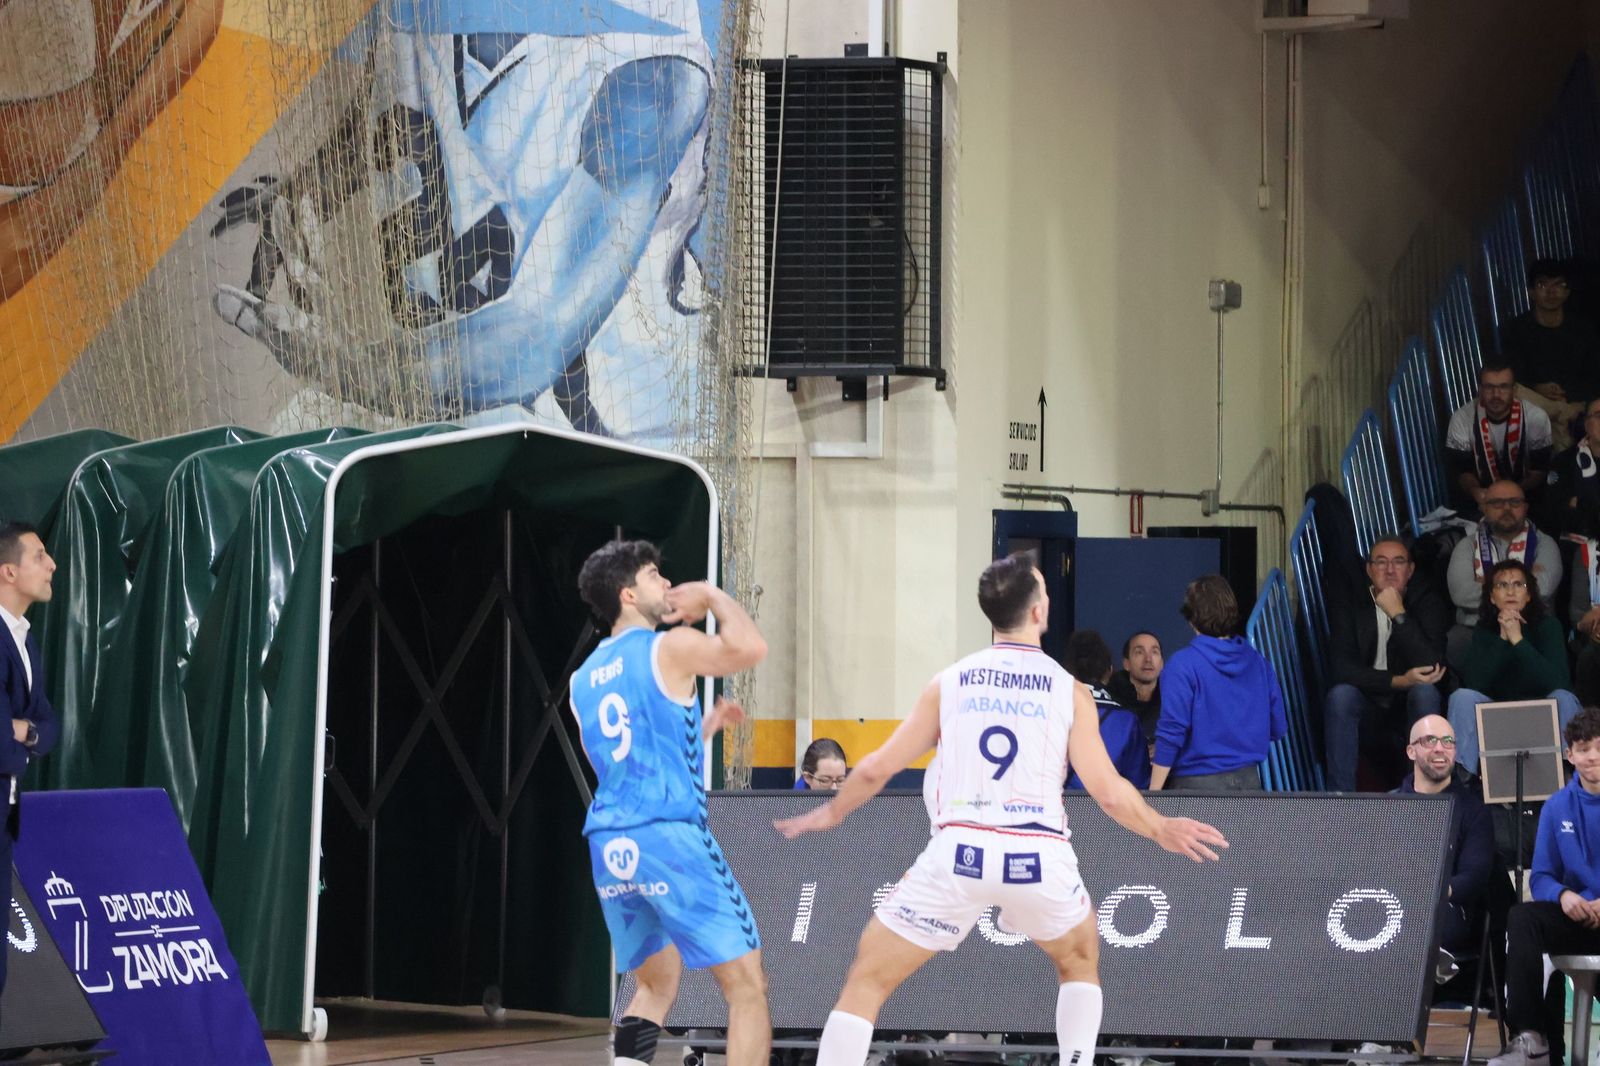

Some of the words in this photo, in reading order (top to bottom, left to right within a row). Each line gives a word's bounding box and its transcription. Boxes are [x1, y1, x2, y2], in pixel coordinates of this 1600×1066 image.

[1009, 421, 1037, 441] SERVICIOS
[1009, 452, 1028, 471] SALIDA
[960, 668, 1052, 693] WESTERMANN
[598, 692, 632, 763] 9
[979, 725, 1018, 781] 9
[112, 938, 229, 990] ZAMORA
